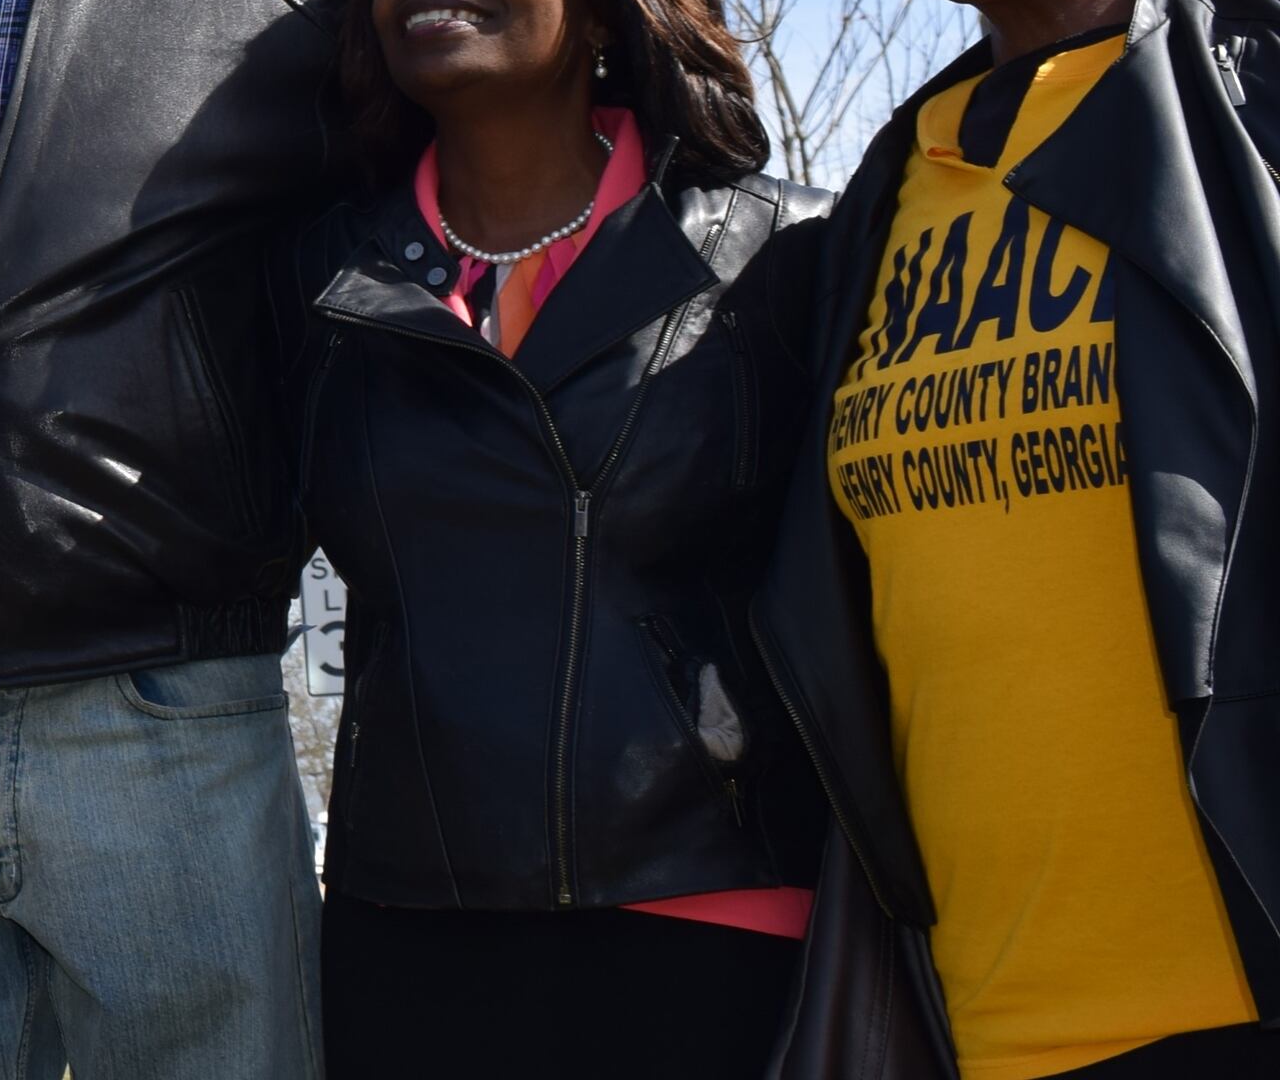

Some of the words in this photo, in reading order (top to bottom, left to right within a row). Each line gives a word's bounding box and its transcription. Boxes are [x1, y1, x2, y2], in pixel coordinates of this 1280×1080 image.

[831, 382, 895, 455] HENRY
[895, 357, 1016, 435] COUNTY
[837, 453, 902, 520] HENRY
[902, 436, 1009, 514] COUNTY,
[1011, 422, 1131, 497] GEORGIA
